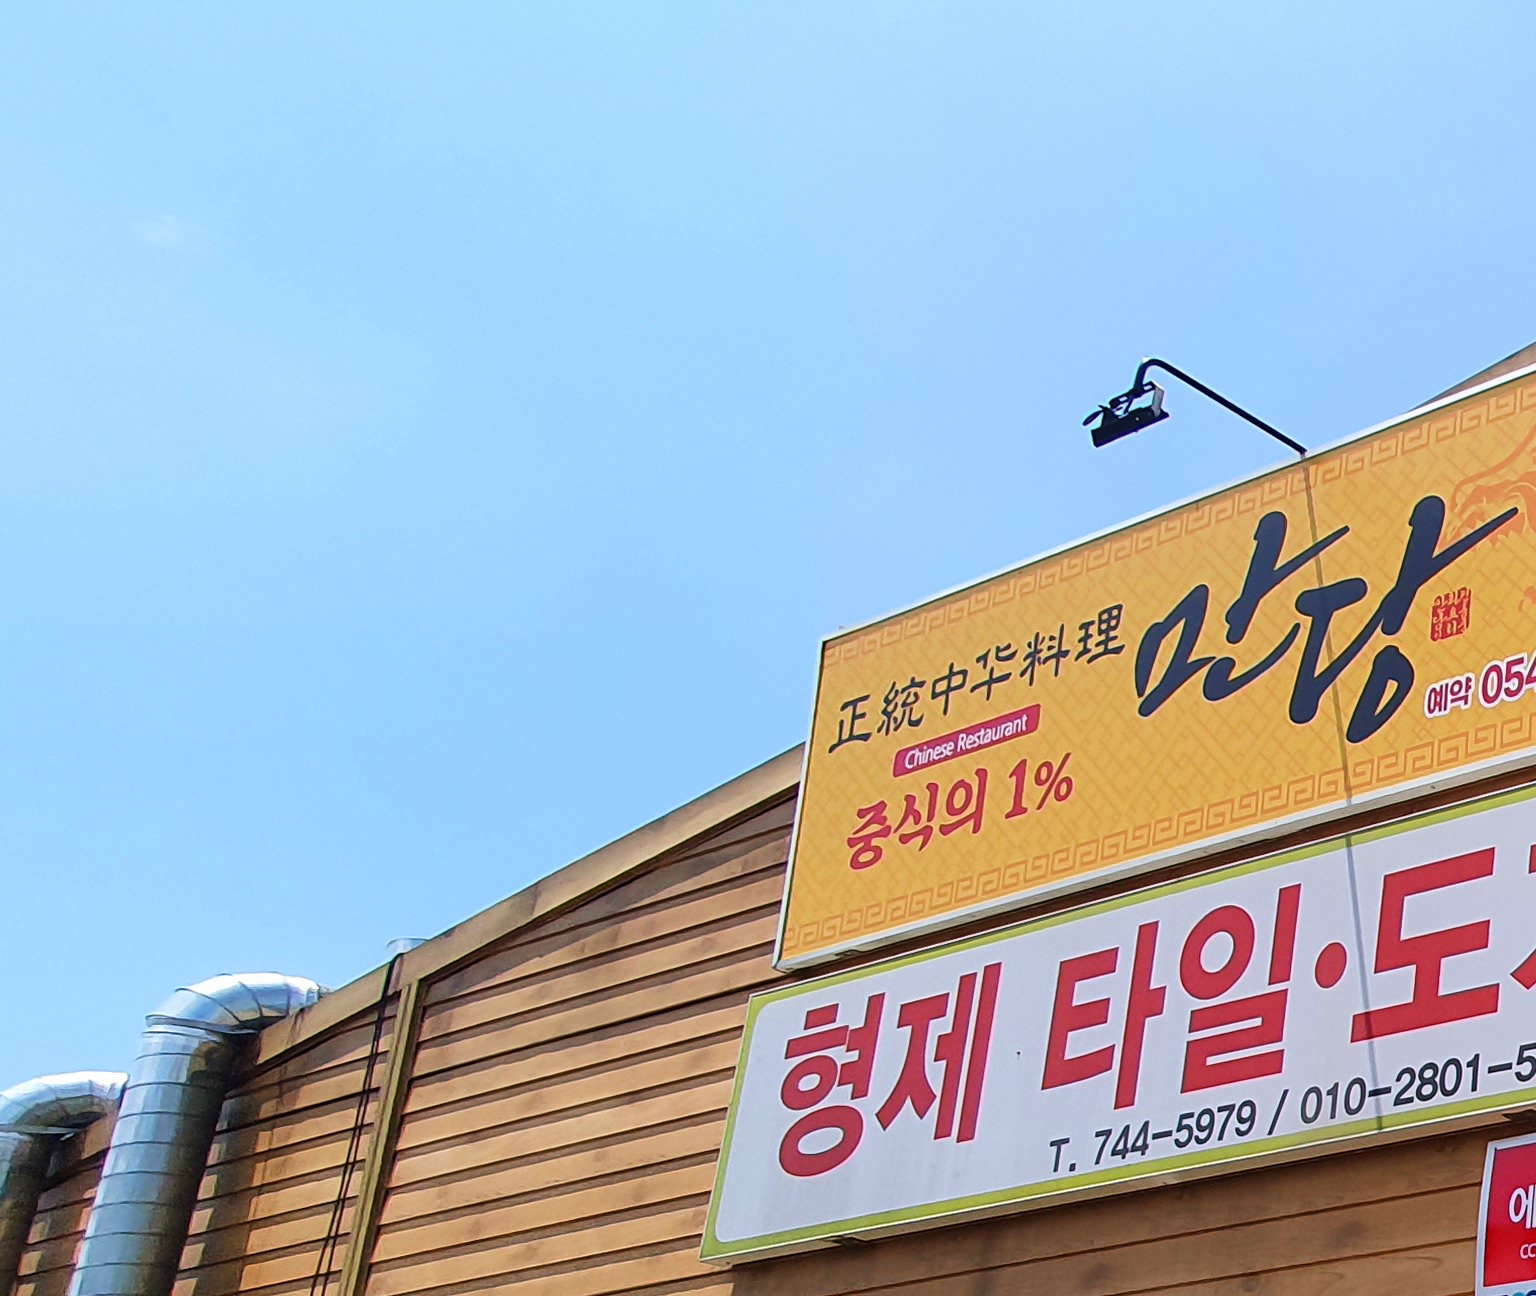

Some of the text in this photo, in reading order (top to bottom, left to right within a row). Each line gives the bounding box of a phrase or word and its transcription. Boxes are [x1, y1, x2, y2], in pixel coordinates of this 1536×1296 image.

[1135, 495, 1518, 743] 만당
[904, 715, 1028, 770] Chinese Restaurant
[1427, 677, 1472, 714] 예약
[847, 753, 1073, 870] 중식의 1%
[777, 962, 1002, 1177] 형제
[1049, 1138, 1077, 1173] T.
[1094, 1100, 1256, 1167] 744-5979
